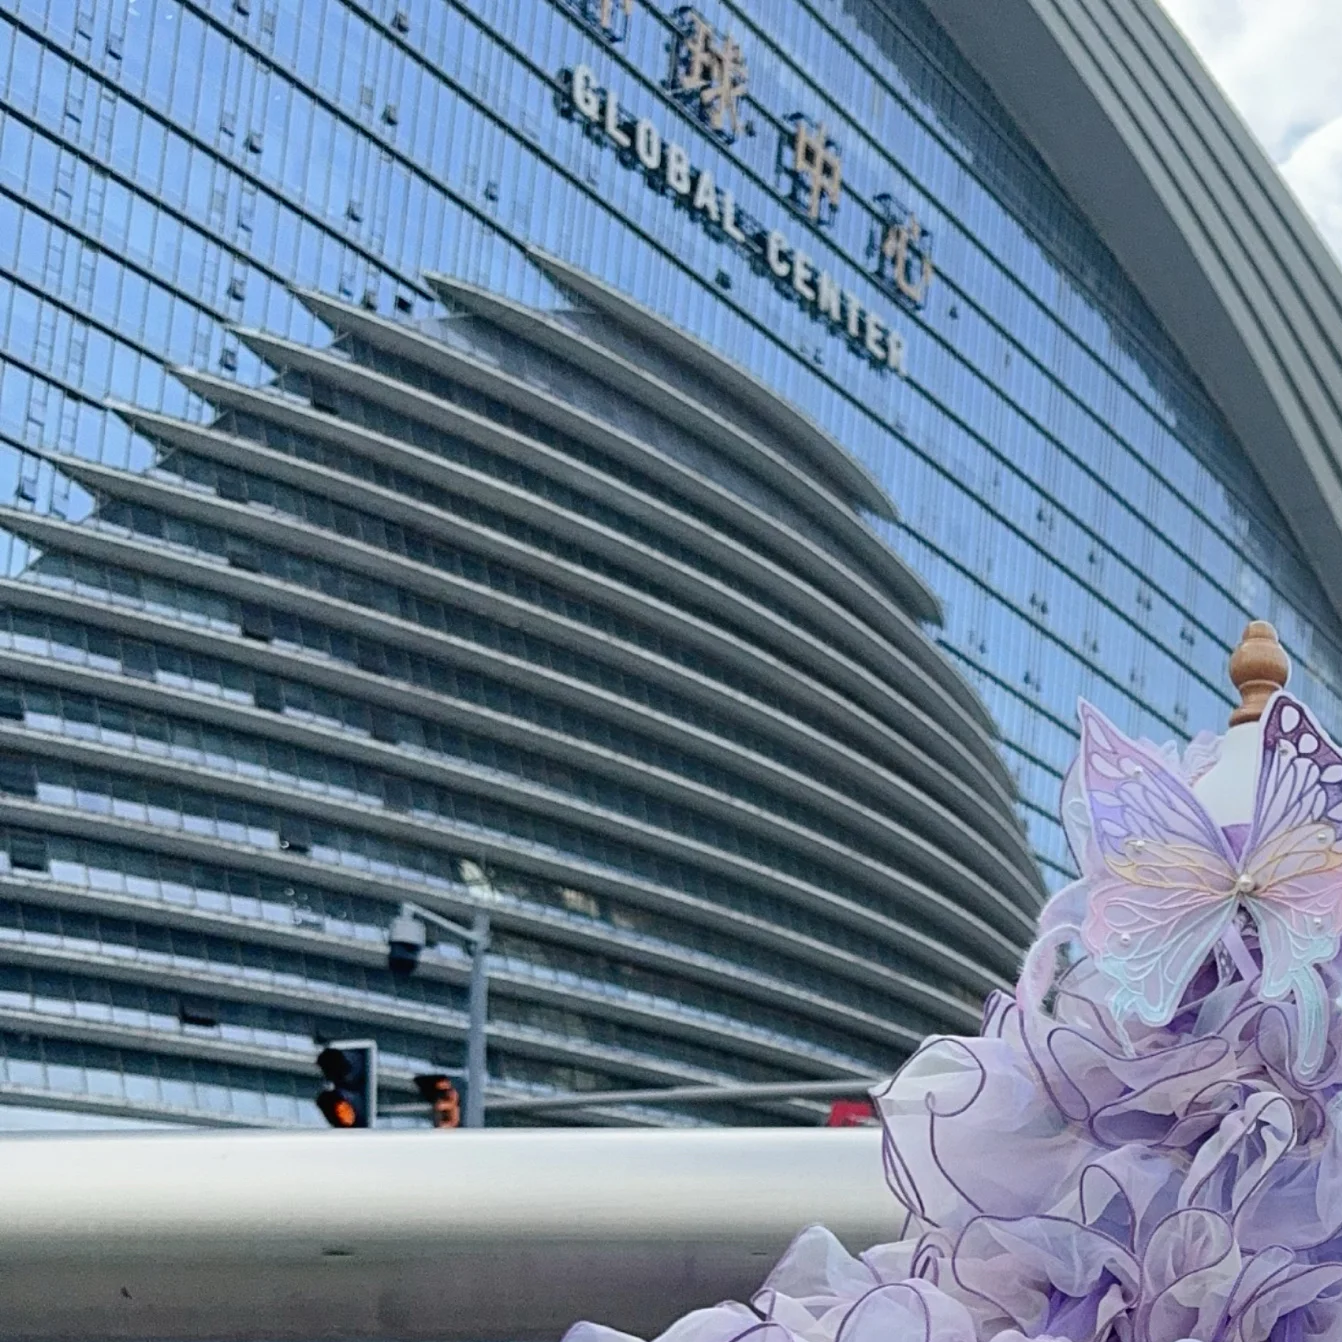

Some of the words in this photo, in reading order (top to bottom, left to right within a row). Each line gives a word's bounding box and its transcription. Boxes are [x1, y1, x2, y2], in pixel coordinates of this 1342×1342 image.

[573, 65, 746, 243] GLOBAL
[766, 230, 906, 374] CENTER
[600, 0, 933, 301] 球中心
